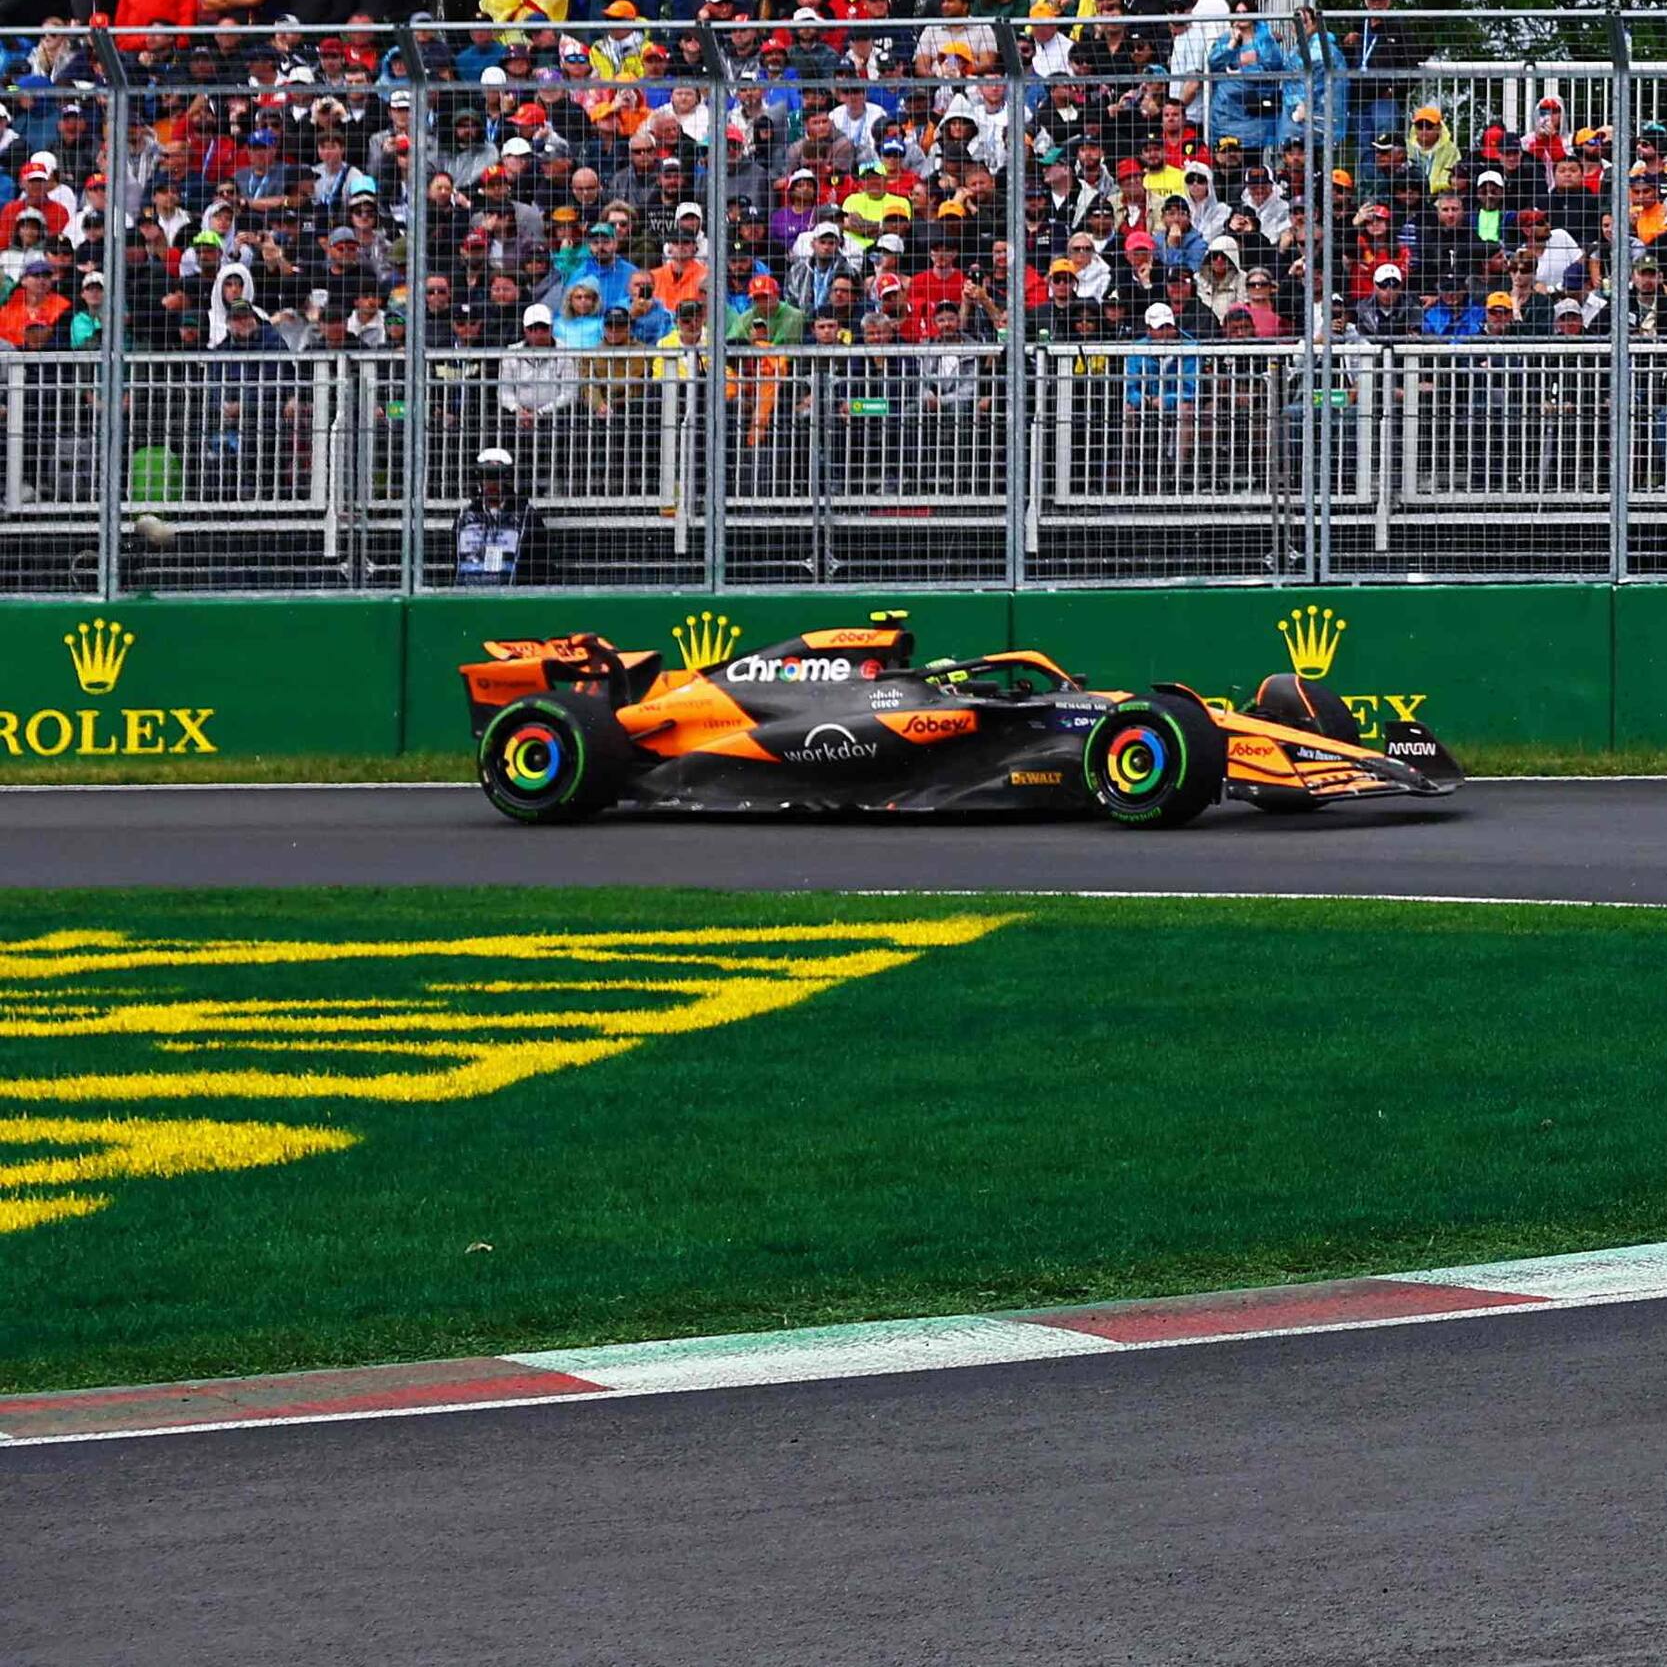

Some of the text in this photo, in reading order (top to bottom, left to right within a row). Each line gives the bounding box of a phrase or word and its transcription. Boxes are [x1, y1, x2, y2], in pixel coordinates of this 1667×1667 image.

[727, 654, 851, 682] Chrome
[902, 717, 970, 734] Sobeys
[784, 742, 877, 762] workday
